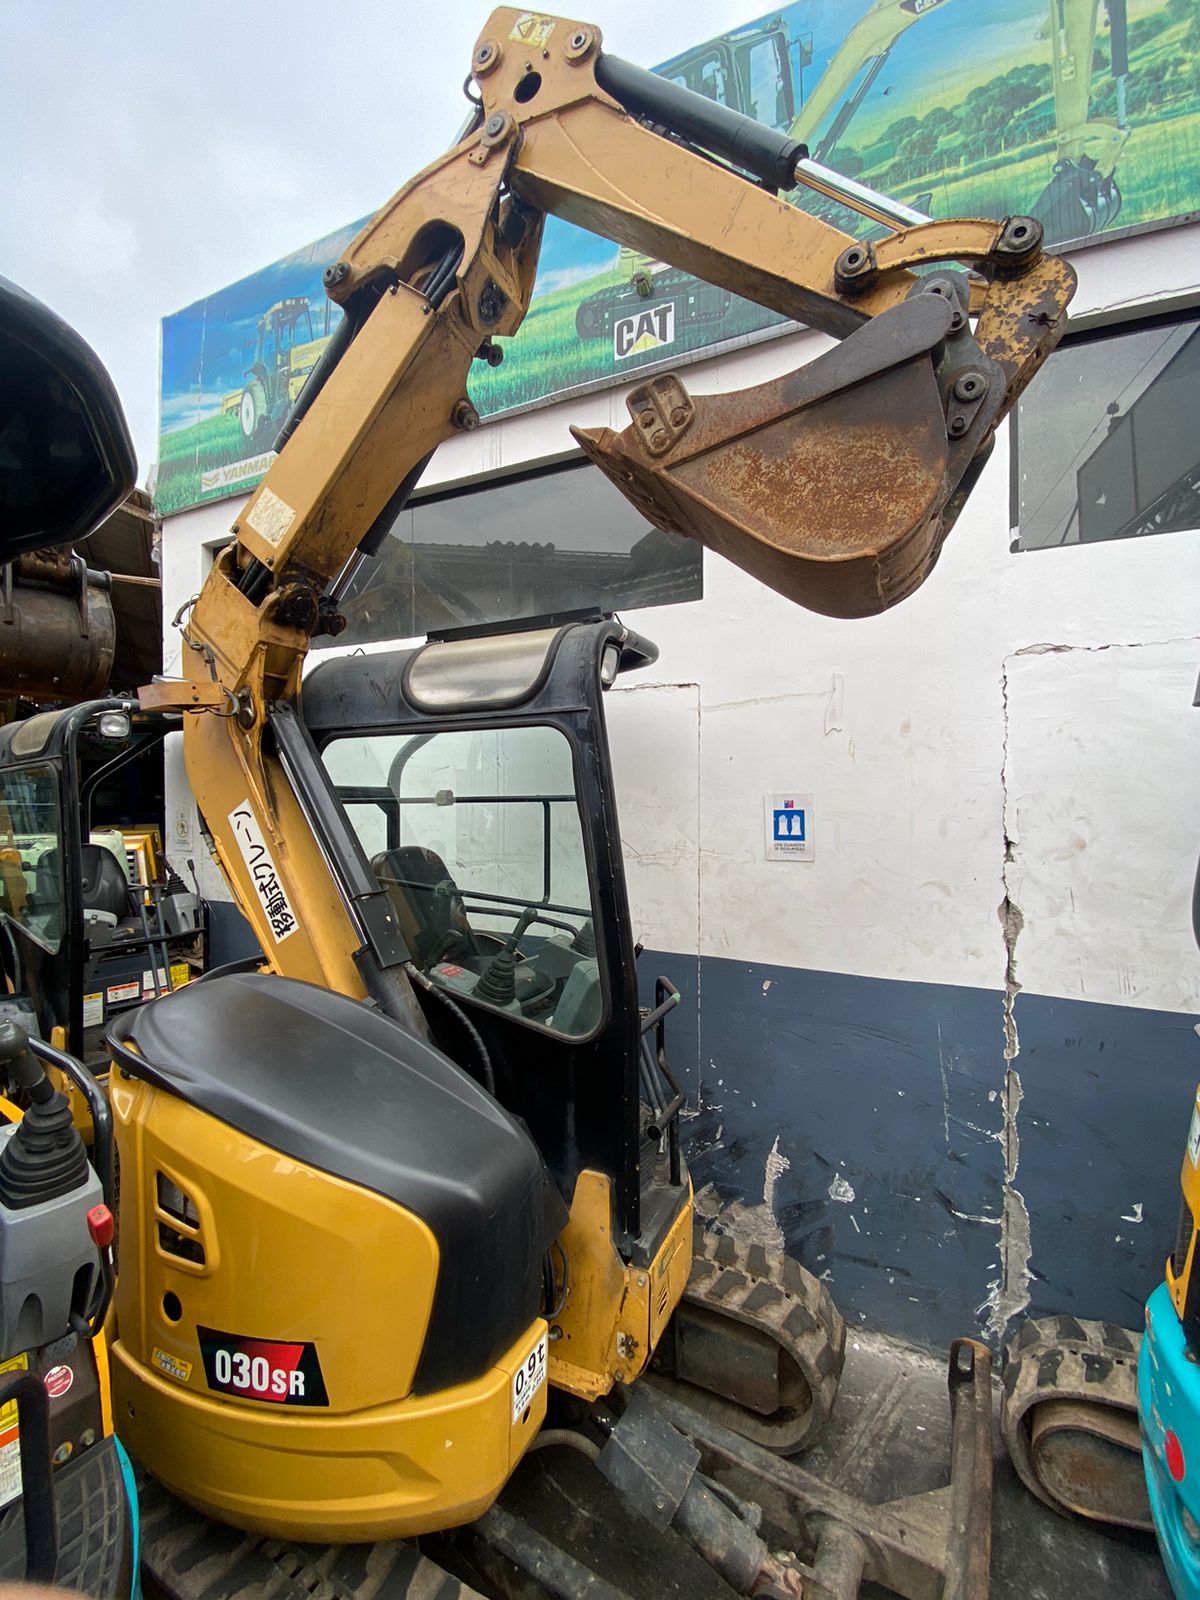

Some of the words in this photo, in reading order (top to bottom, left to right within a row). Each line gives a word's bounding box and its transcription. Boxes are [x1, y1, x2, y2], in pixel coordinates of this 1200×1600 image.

[616, 303, 673, 356] CAT
[234, 811, 295, 938] 移動式クレーン
